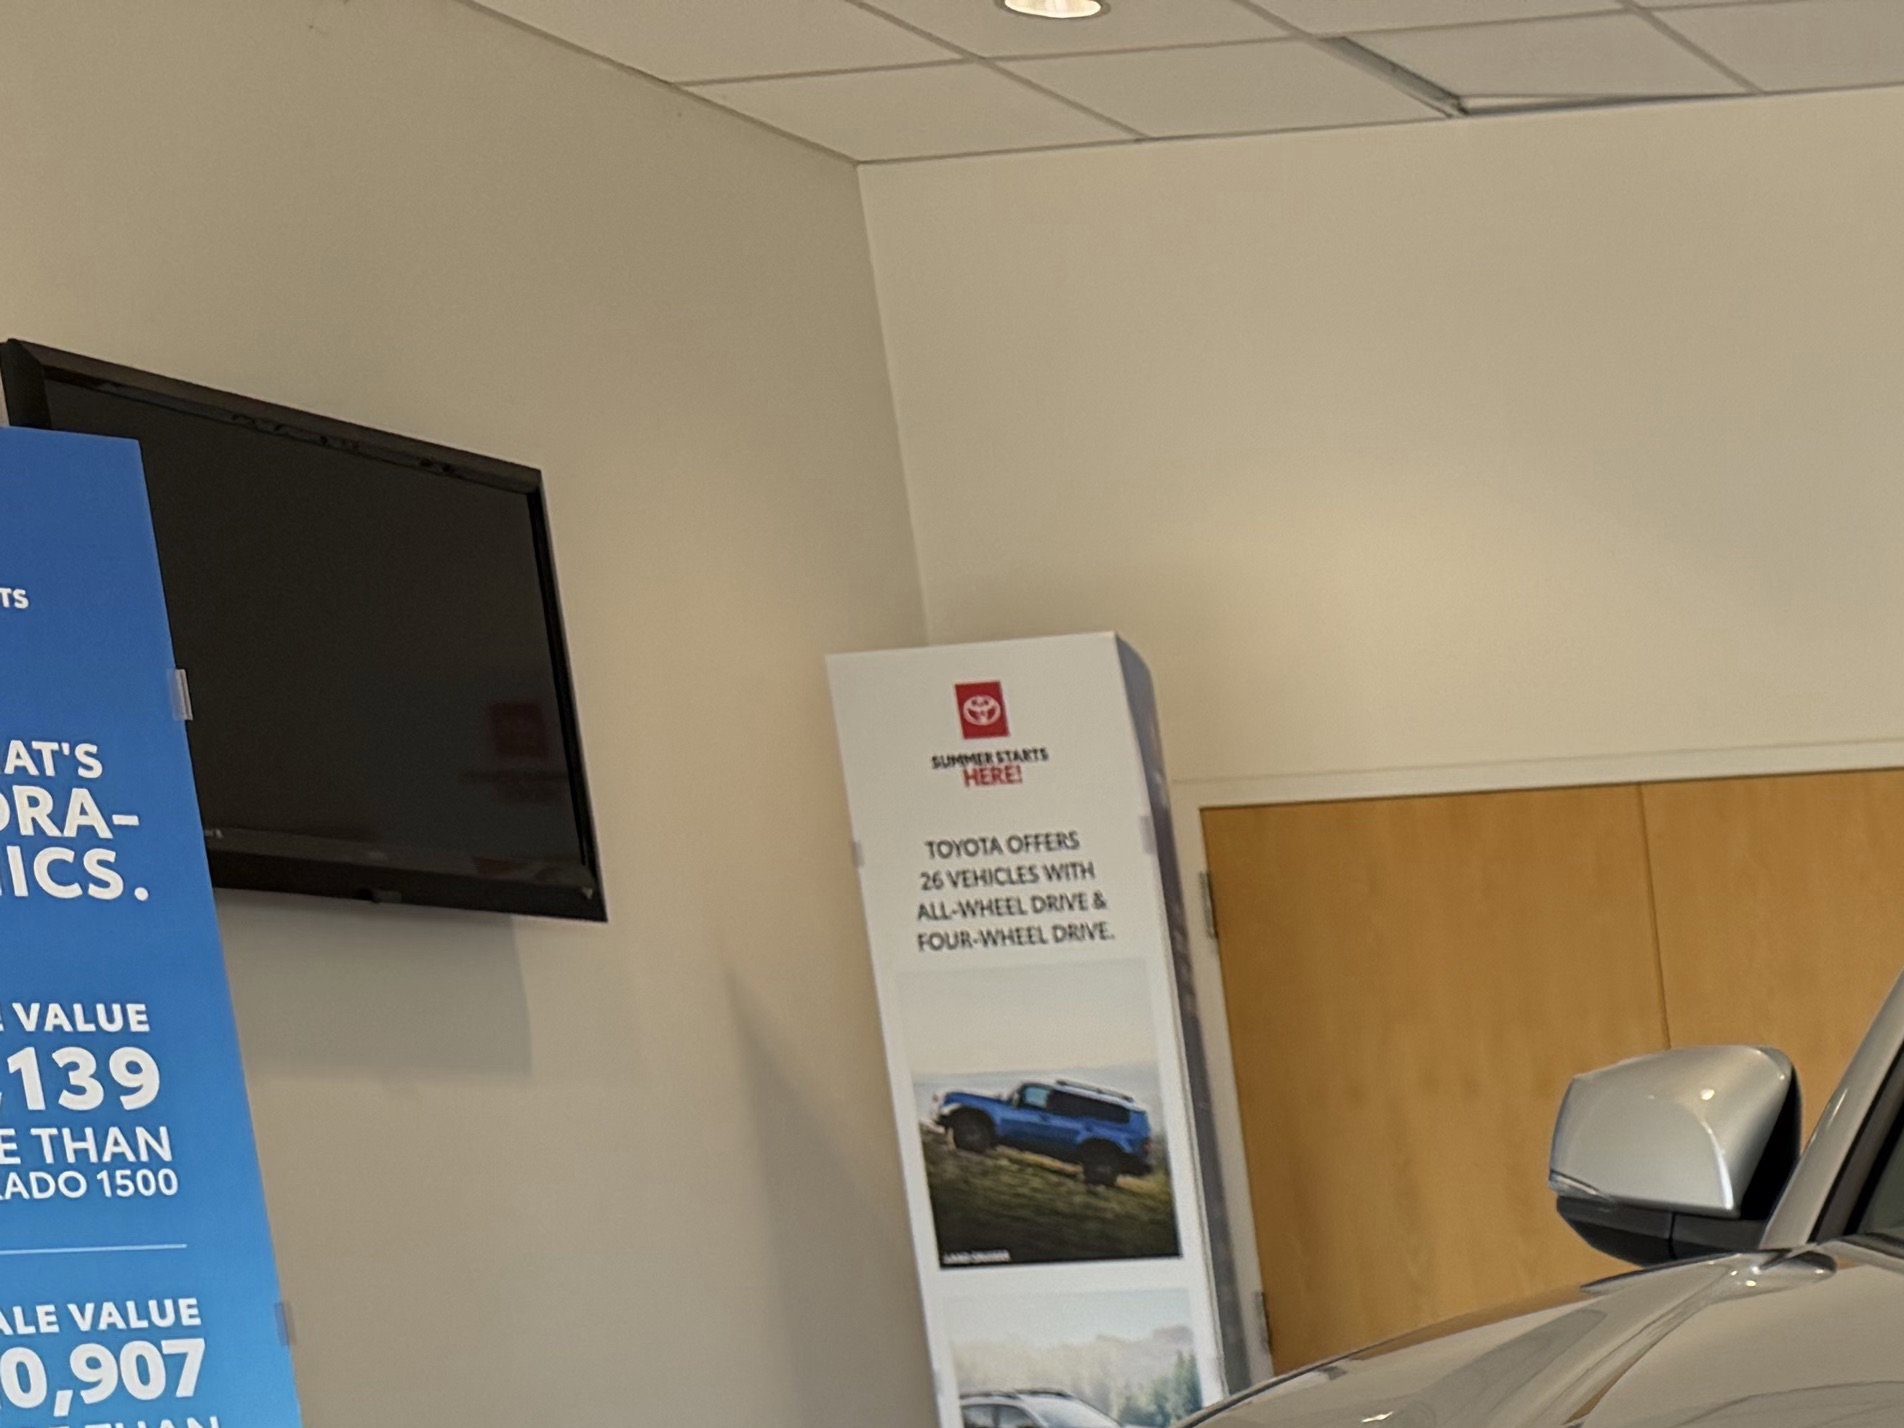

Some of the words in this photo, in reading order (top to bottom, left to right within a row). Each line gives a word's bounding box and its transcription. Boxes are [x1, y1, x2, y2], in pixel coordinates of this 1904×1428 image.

[931, 751, 994, 770] SUMMER
[996, 747, 1049, 763] STARTS
[963, 765, 1023, 788] HERE!
[925, 836, 1003, 860] TOYOTA
[1006, 831, 1080, 854] OFFERS
[920, 871, 945, 891] 26
[945, 865, 1040, 889] VEHICLES
[1043, 861, 1095, 882] WITH
[917, 897, 1028, 921] ALL-WHEEL
[1031, 892, 1088, 915] DRIVE
[1091, 891, 1107, 909] &
[918, 928, 1048, 952] FOUR-WHEEL
[1052, 921, 1115, 944] DRIVE.
[12, 1003, 150, 1032] VALUE
[30, 1126, 173, 1164] THAN
[97, 1168, 178, 1198] 1500
[67, 1298, 201, 1331] VALUE
